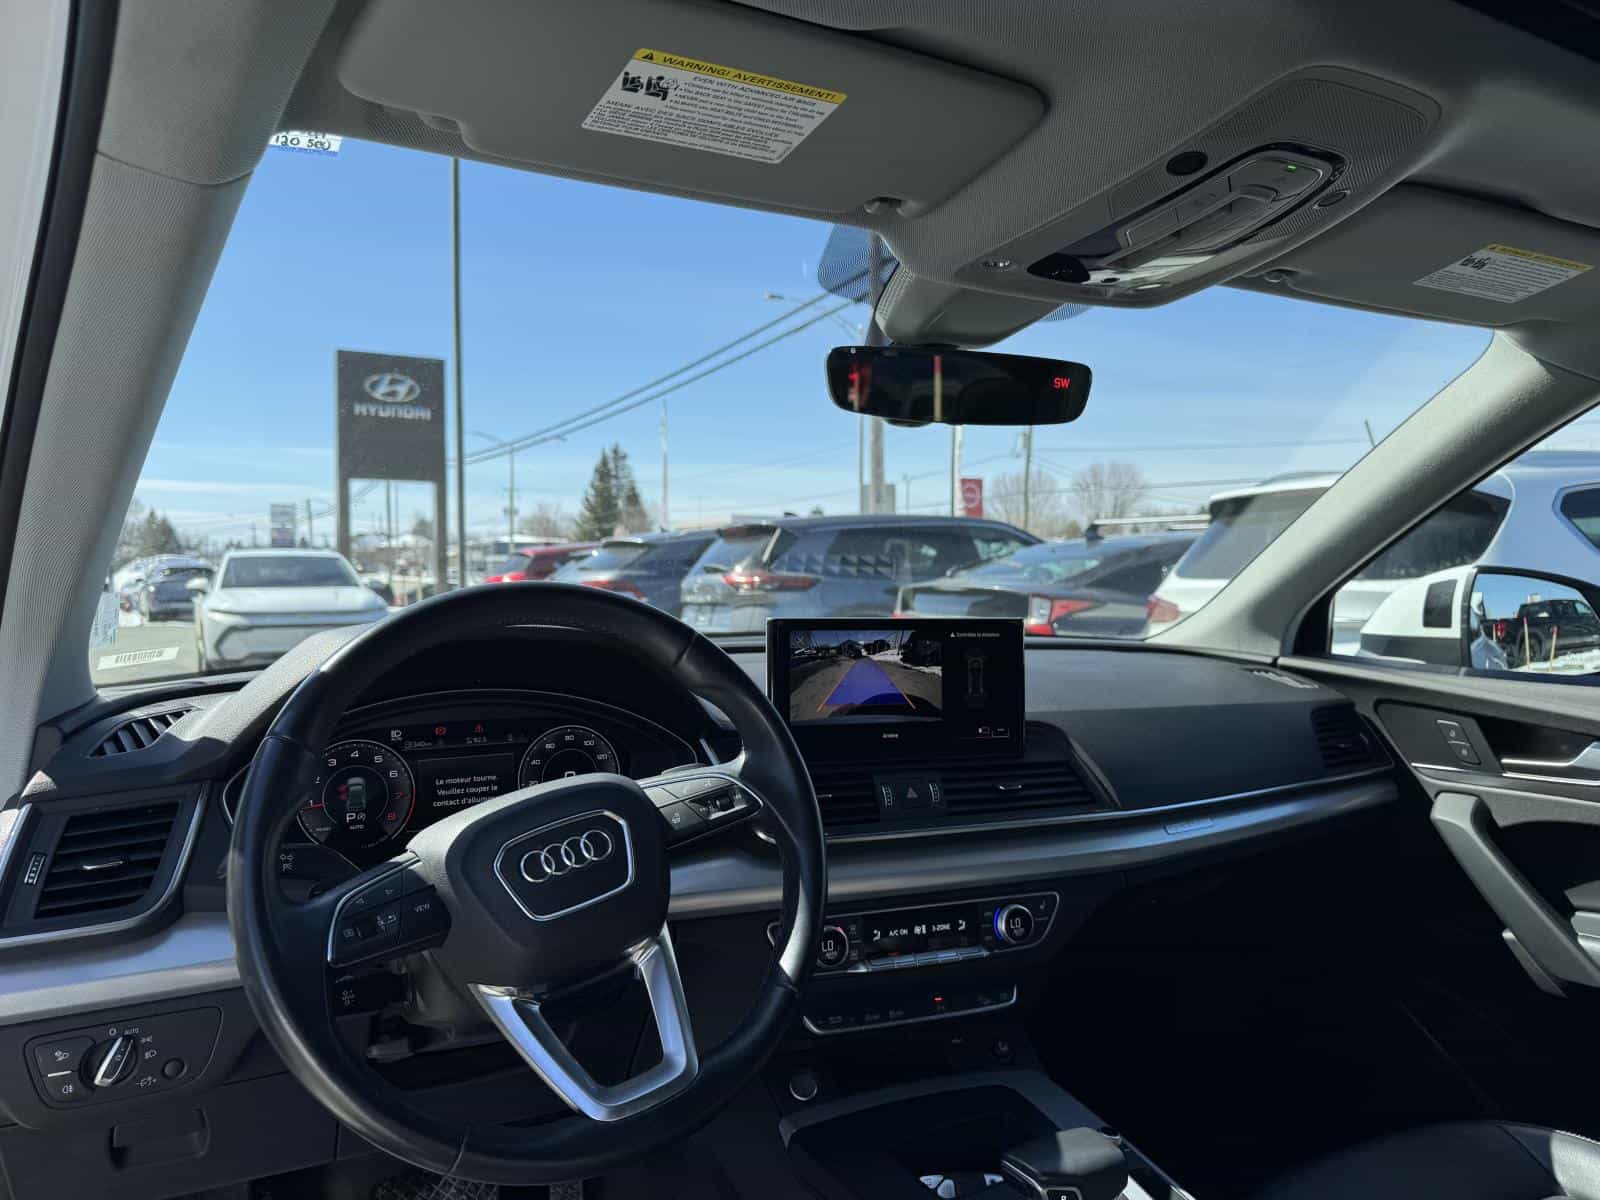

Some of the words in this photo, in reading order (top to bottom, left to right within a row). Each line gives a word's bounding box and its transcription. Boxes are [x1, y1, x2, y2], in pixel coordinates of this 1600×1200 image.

[663, 56, 730, 76] WARNING!
[732, 72, 837, 100] AVERTISSEMENT!
[276, 136, 300, 147] 120
[1054, 377, 1070, 389] SW
[352, 402, 432, 421] HYUNDAI
[437, 788, 464, 796] Veuillez
[346, 812, 356, 823] P
[822, 940, 834, 952] LO
